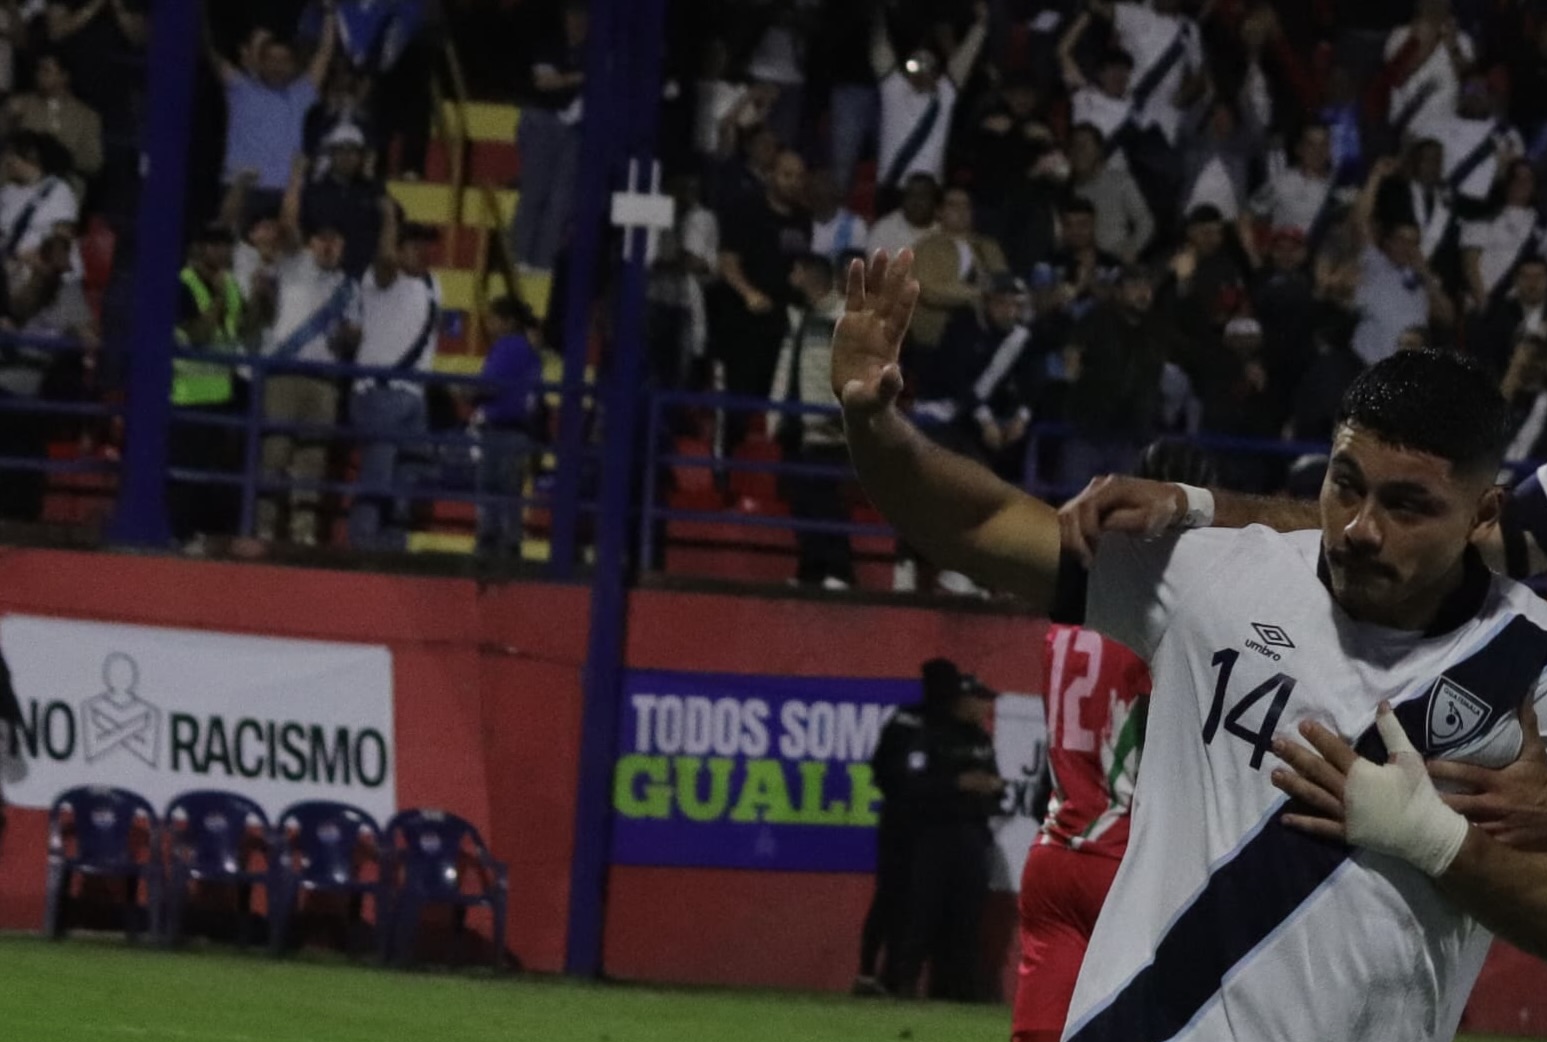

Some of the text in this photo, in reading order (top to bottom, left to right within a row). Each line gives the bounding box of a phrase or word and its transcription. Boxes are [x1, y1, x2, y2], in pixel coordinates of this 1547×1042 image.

[1050, 629, 1103, 752] 12
[1245, 639, 1281, 662] umbro
[15, 701, 387, 788] NO RACISMO
[631, 693, 771, 757] TODOS
[1202, 648, 1297, 771] 14
